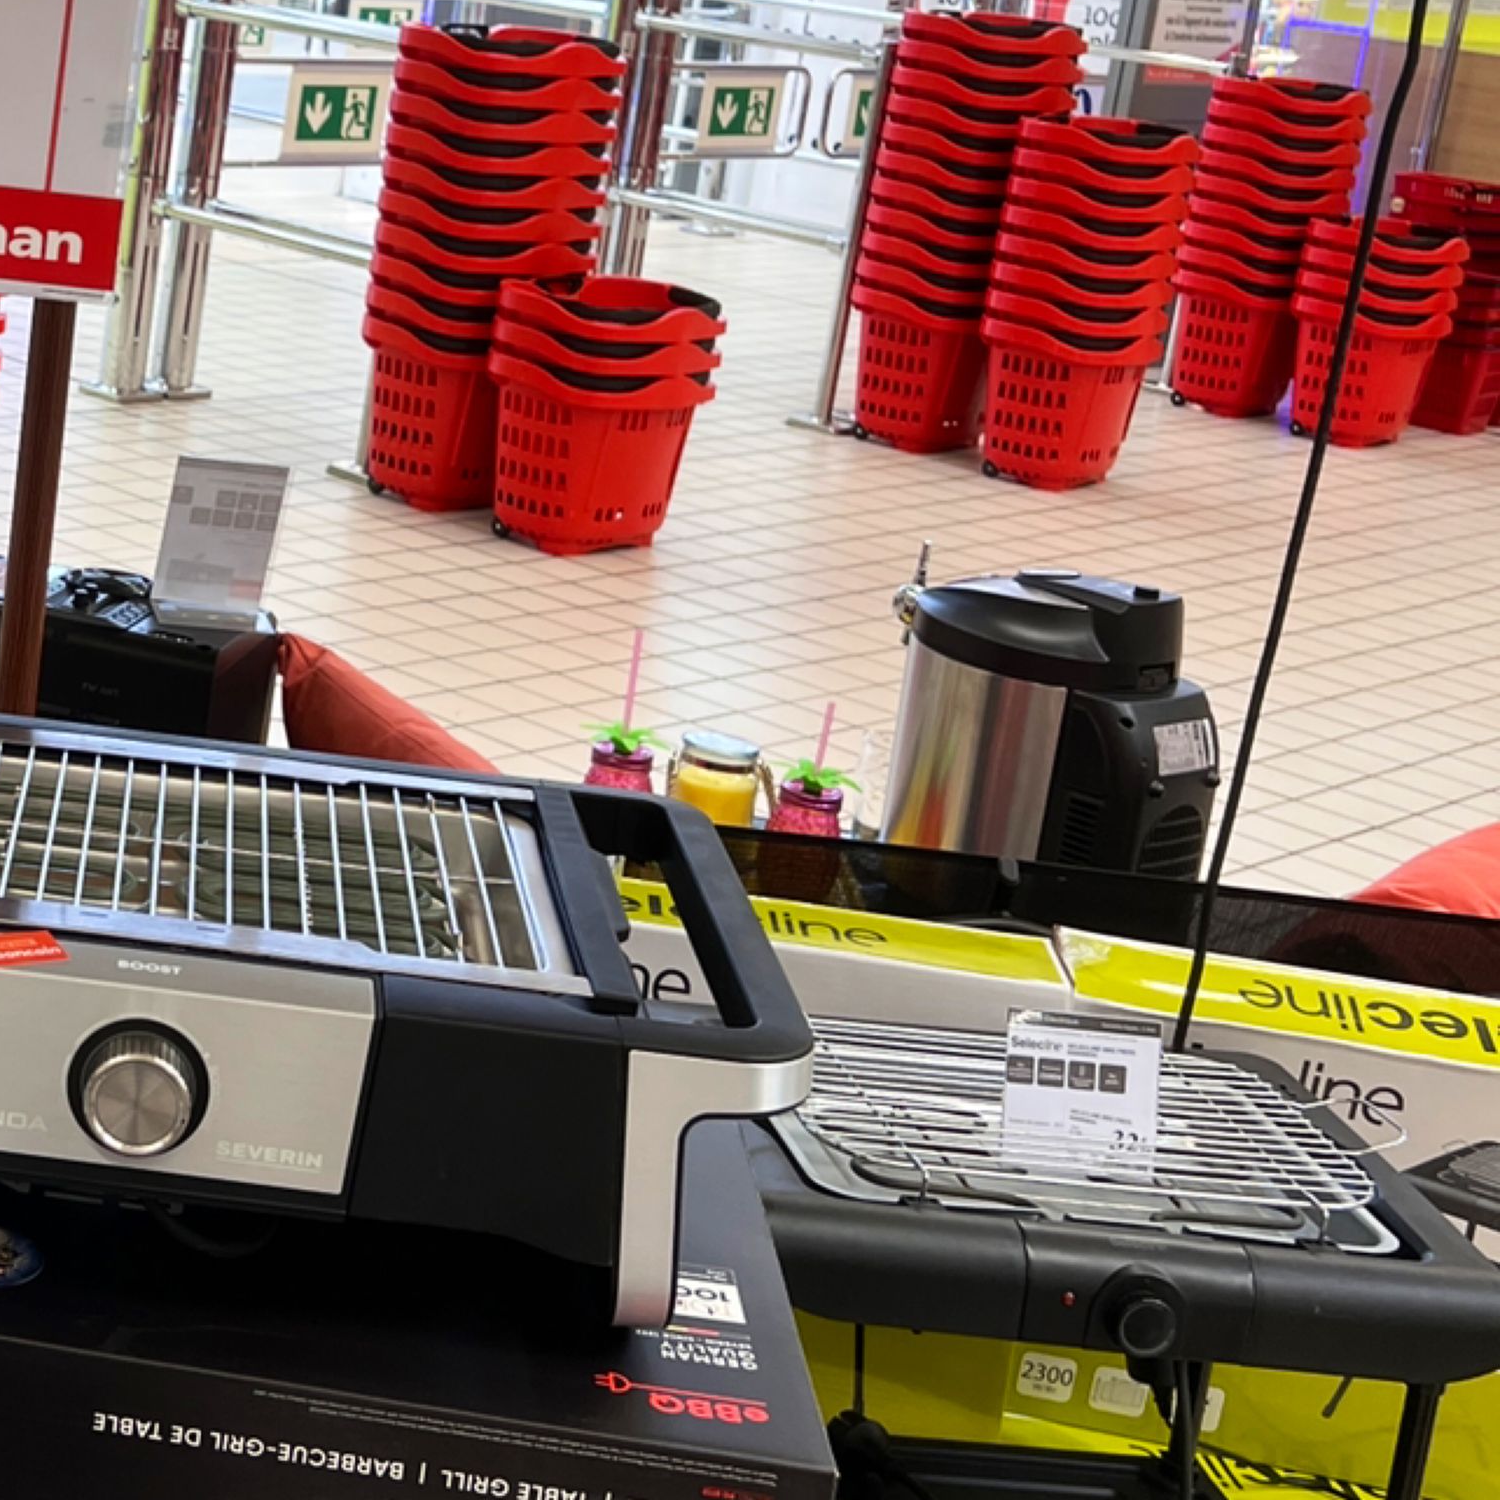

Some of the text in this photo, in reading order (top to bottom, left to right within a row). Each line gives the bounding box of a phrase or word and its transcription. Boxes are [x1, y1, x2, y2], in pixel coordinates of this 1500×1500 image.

[117, 959, 182, 976] BOOST
[215, 1140, 324, 1169] SEVERIN
[660, 1340, 755, 1361] QUALITY
[660, 1349, 758, 1371] GERMAN
[1020, 1359, 1074, 1387] 2300
[649, 1392, 770, 1425] eBBQ
[92, 1411, 163, 1441] TABLE
[170, 1425, 202, 1448] DE
[210, 1431, 406, 1481] BARBECUE-GRIL
[440, 1468, 510, 1497] GRILL
